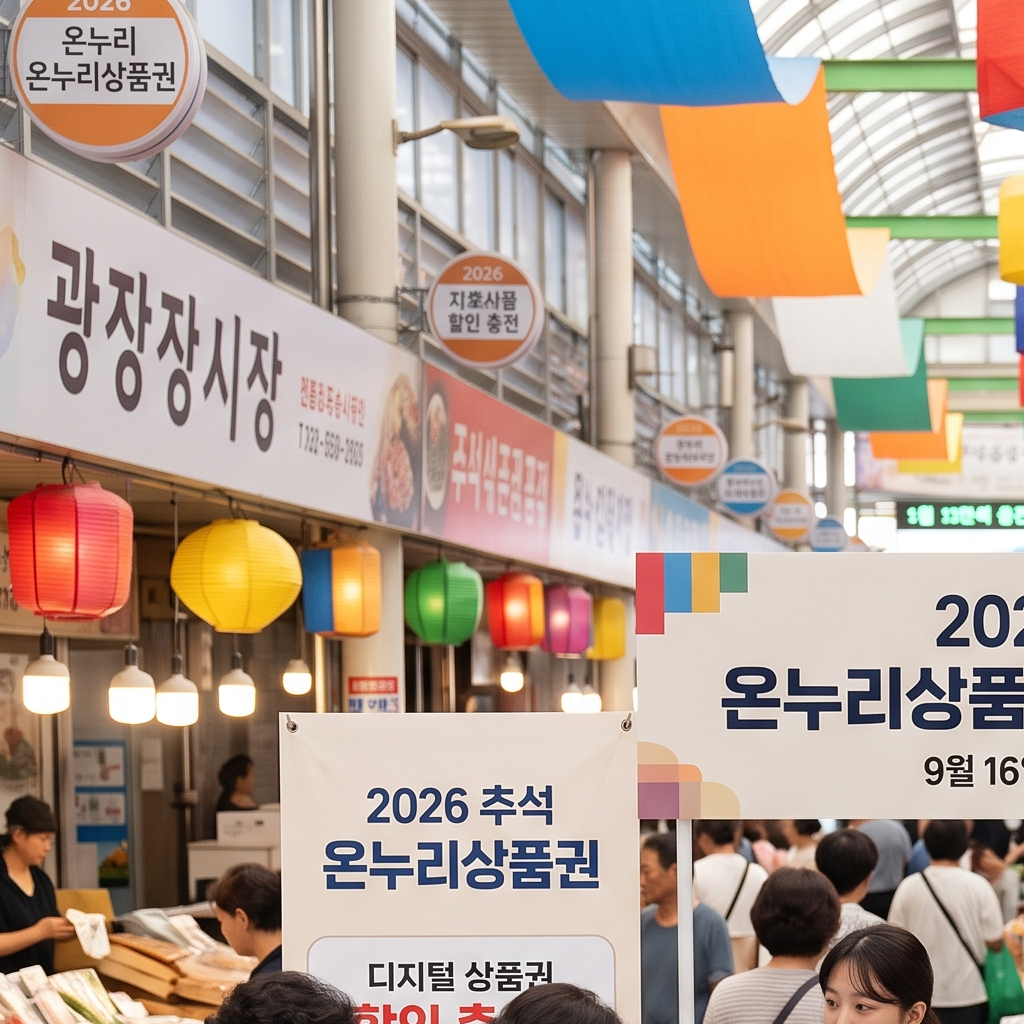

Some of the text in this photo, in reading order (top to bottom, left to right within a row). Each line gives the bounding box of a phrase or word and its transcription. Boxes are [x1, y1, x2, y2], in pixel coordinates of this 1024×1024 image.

[66, 0, 132, 12] 2026
[61, 25, 136, 56] 온누리
[25, 61, 176, 93] 온누리상품권
[462, 265, 504, 282] 2026
[447, 312, 519, 334] 할인 충전
[46, 239, 284, 453] 광장장시장
[924, 754, 975, 788] 9월
[366, 784, 554, 826] 2026 추석
[322, 839, 600, 891] 온누리상품권
[367, 961, 553, 993] 디지털 상품권
